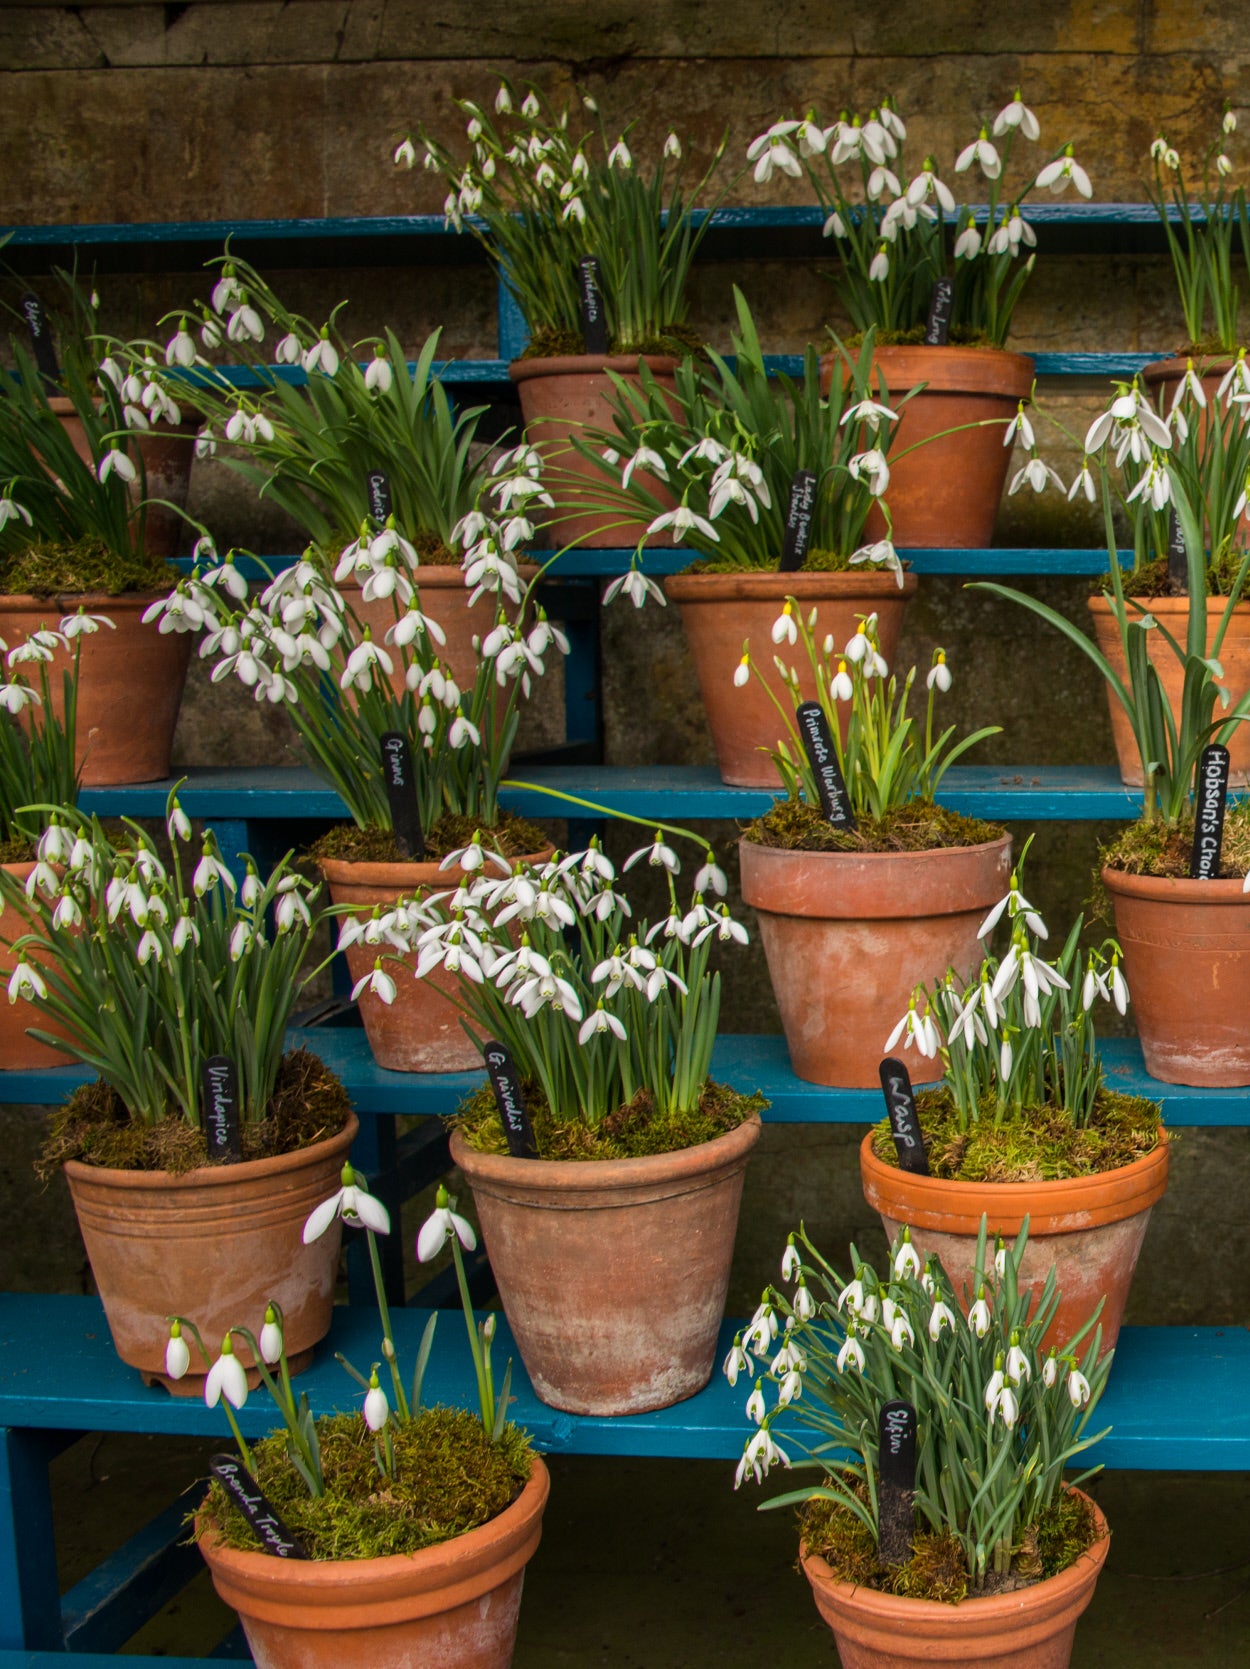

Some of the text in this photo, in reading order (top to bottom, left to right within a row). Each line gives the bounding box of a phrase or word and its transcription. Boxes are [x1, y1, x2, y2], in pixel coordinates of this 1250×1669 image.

[928, 281, 952, 345] John Long
[799, 477, 816, 512] Lady
[803, 709, 846, 822] Primrose Warburg
[496, 1076, 522, 1131] nivalis
[888, 1076, 915, 1148] Wasp
[216, 1463, 257, 1514] Brenda
